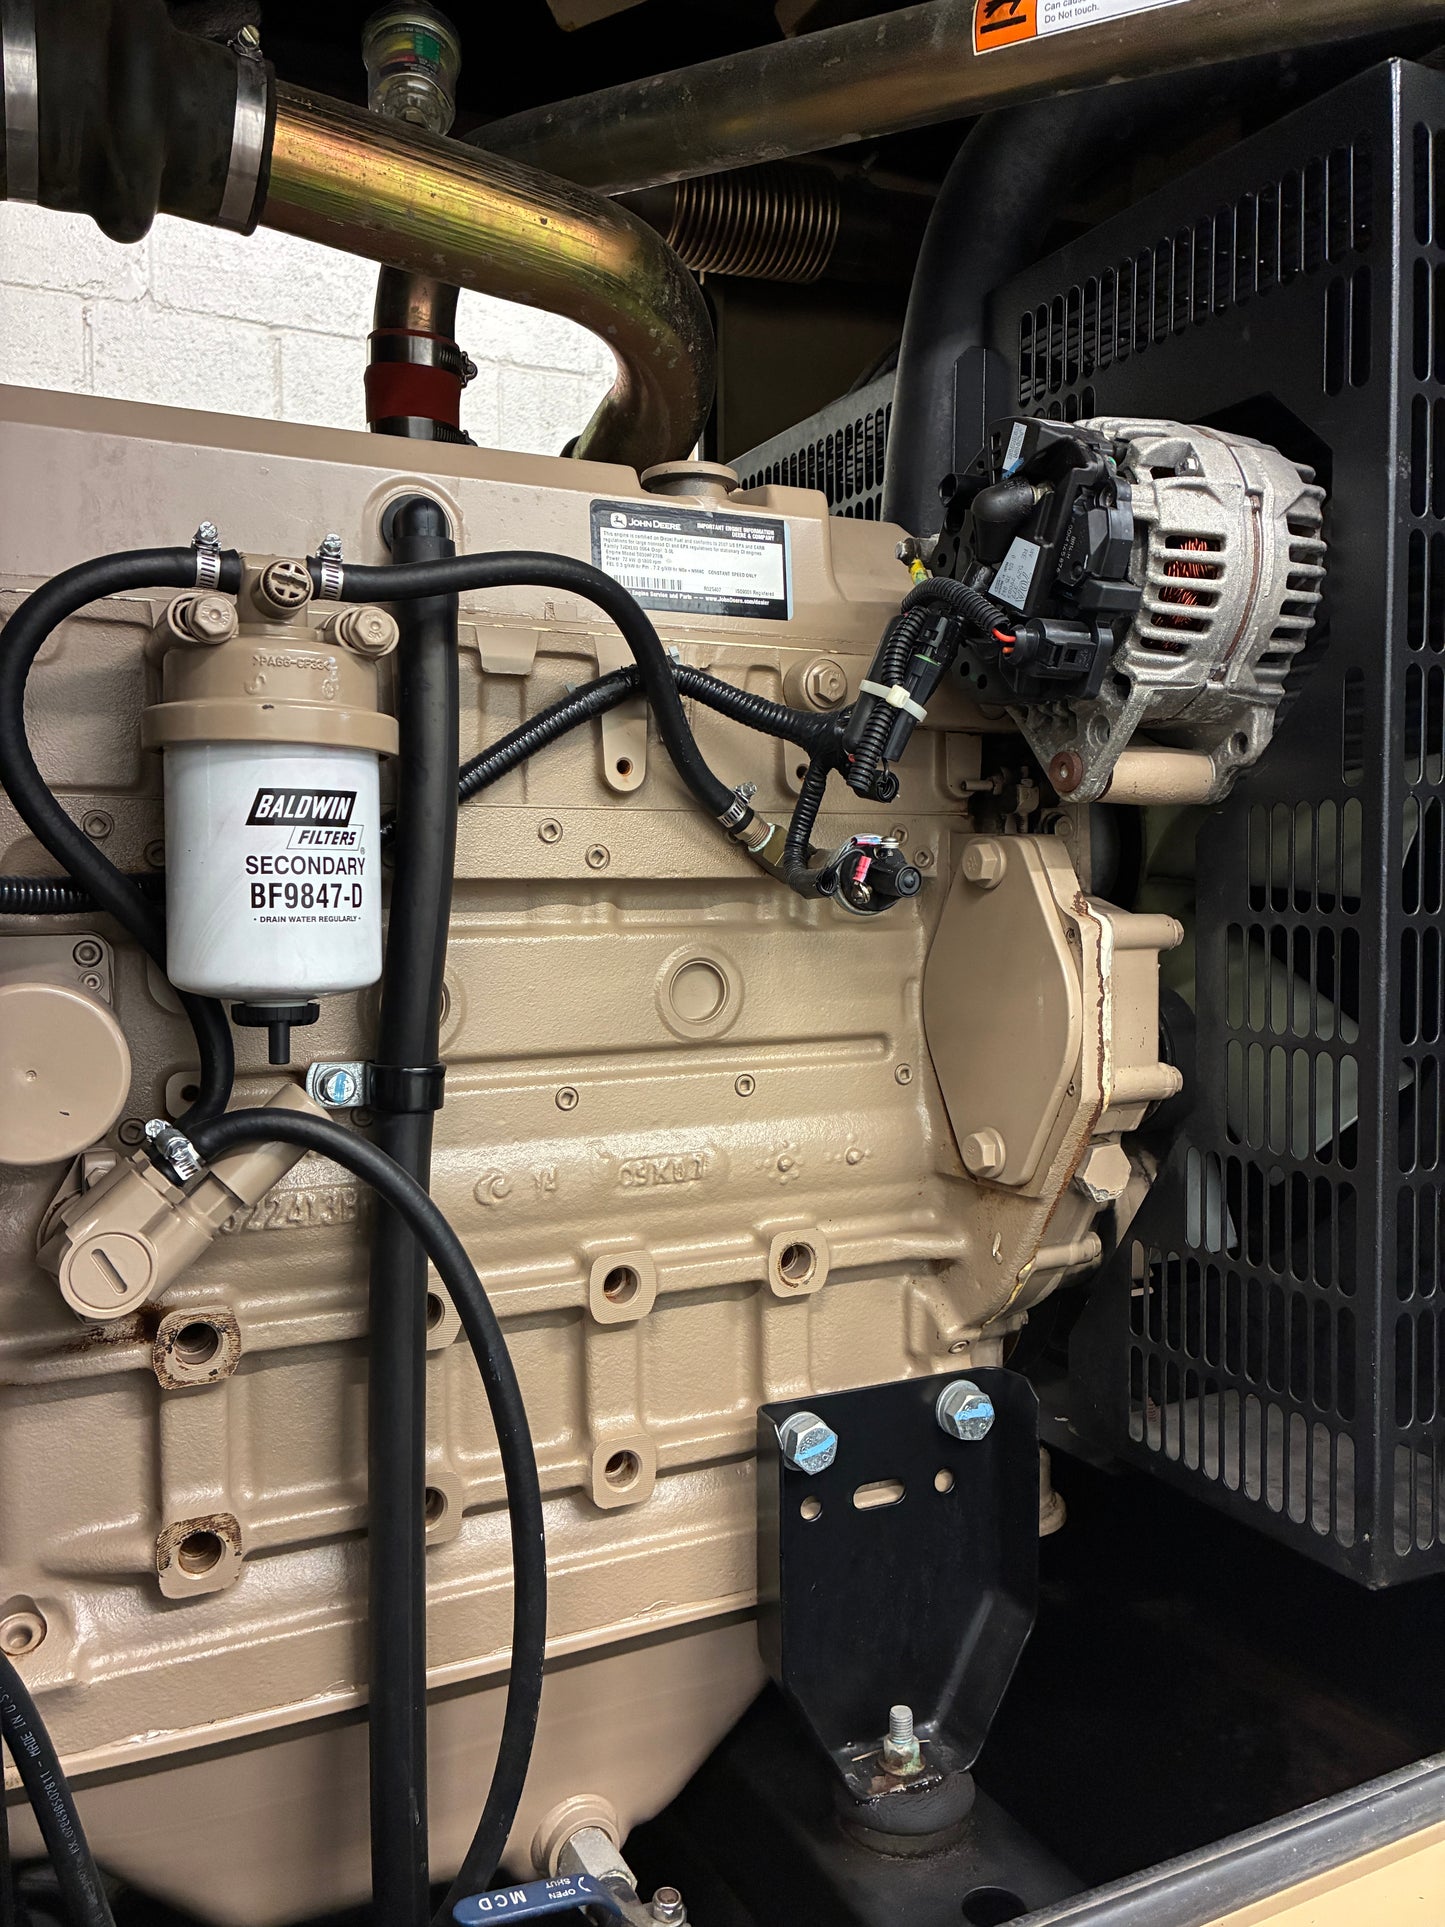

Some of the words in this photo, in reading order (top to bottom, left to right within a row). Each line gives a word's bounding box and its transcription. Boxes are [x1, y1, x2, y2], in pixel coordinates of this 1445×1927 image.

[1044, 2, 1061, 12] Can
[1044, 15, 1056, 24] Do
[1058, 10, 1072, 20] Not
[1075, 3, 1100, 16] touch.
[628, 518, 652, 528] JOHN
[653, 520, 681, 530] DEERE
[696, 522, 724, 531] IMPORTANT
[255, 795, 351, 820] BALDWIN
[298, 830, 356, 845] FILTERS
[246, 855, 365, 875] SECONDARY
[251, 883, 362, 909] BF9847-D
[11, 1714, 26, 1729] IN
[20, 1731, 41, 1757] MADE
[546, 1878, 571, 1889] SHUT
[478, 1890, 527, 1911] MCD
[548, 1889, 576, 1900] OPEN
